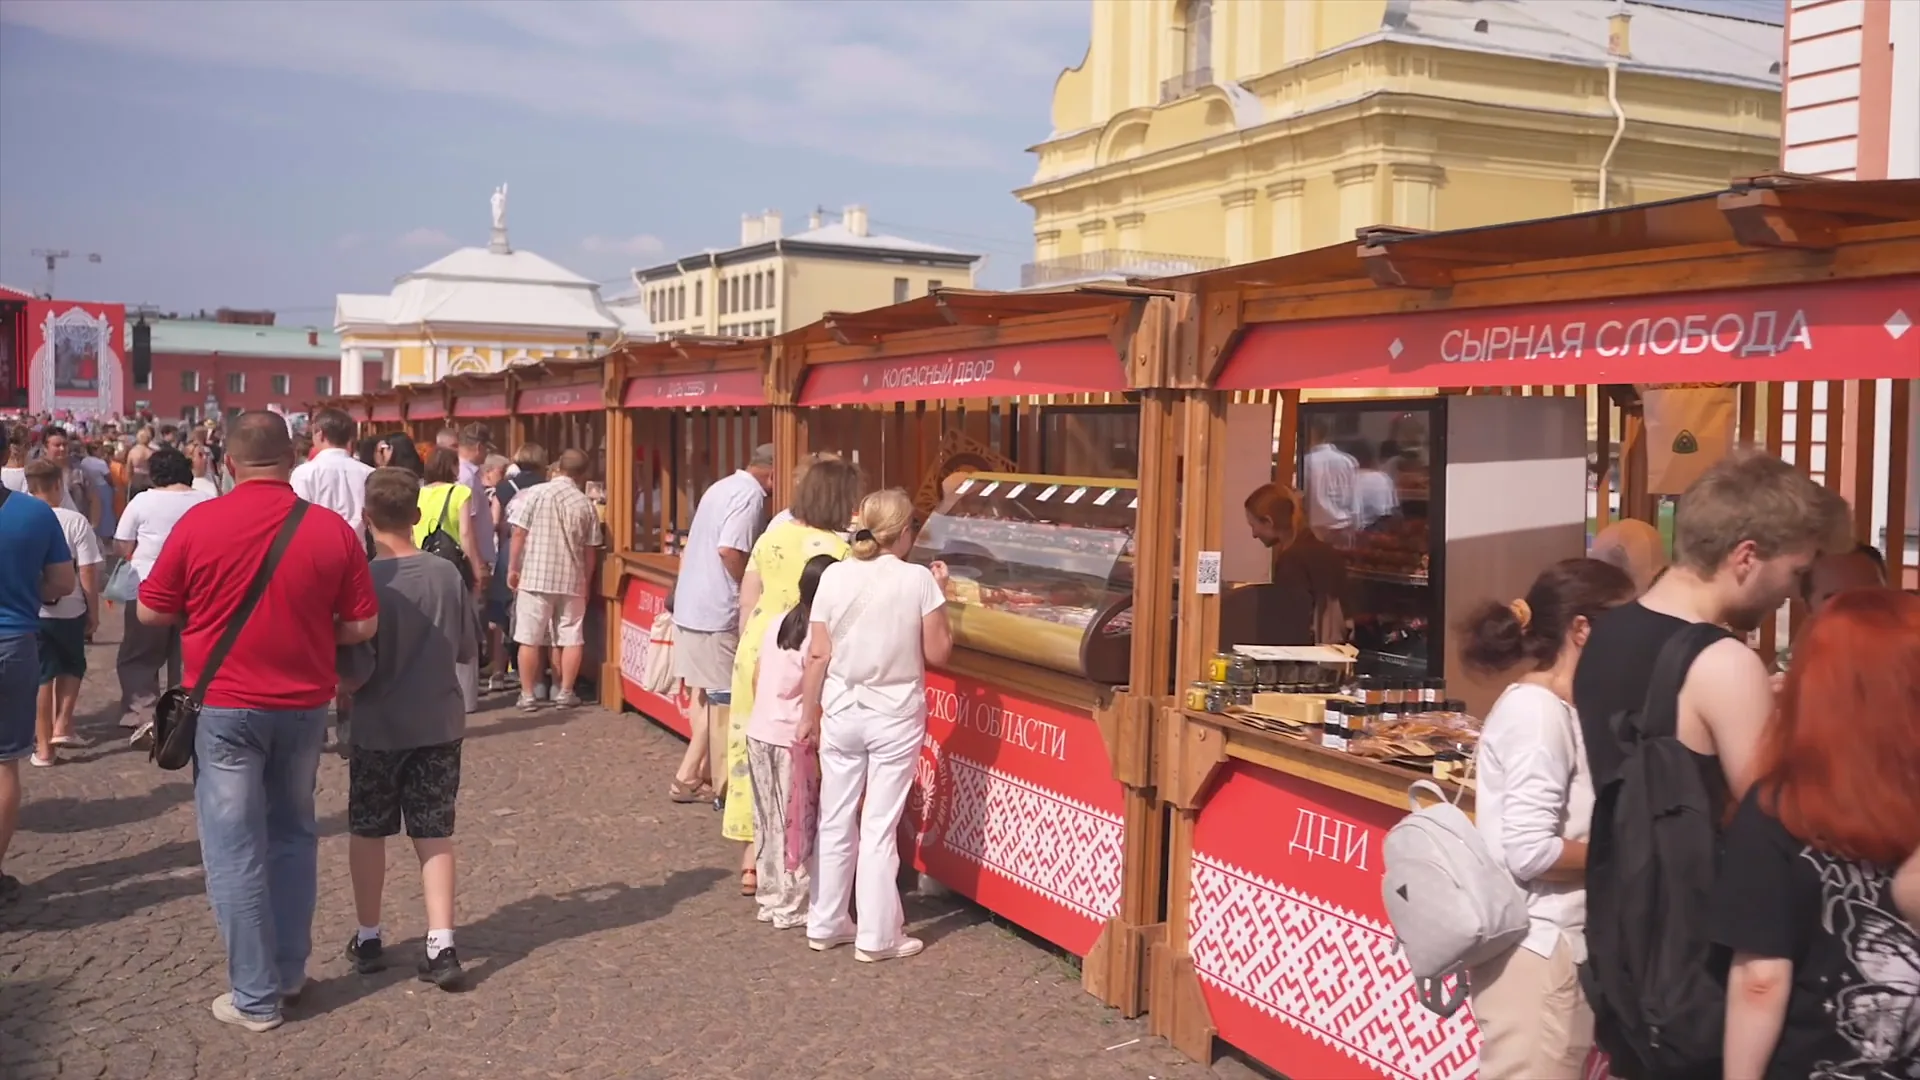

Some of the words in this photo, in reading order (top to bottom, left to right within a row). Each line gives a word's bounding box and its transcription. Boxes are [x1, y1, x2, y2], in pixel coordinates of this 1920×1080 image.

[1441, 321, 1586, 363] СЫРНАЯ
[1595, 309, 1813, 358] СЛОБОДА
[881, 357, 953, 389] КОЛБАСНЫЙ
[953, 359, 995, 387] ДВОР
[924, 686, 970, 728] СКОЙ
[975, 702, 1067, 761] ОБЛАСТИ
[1287, 807, 1369, 872] ДНИ
